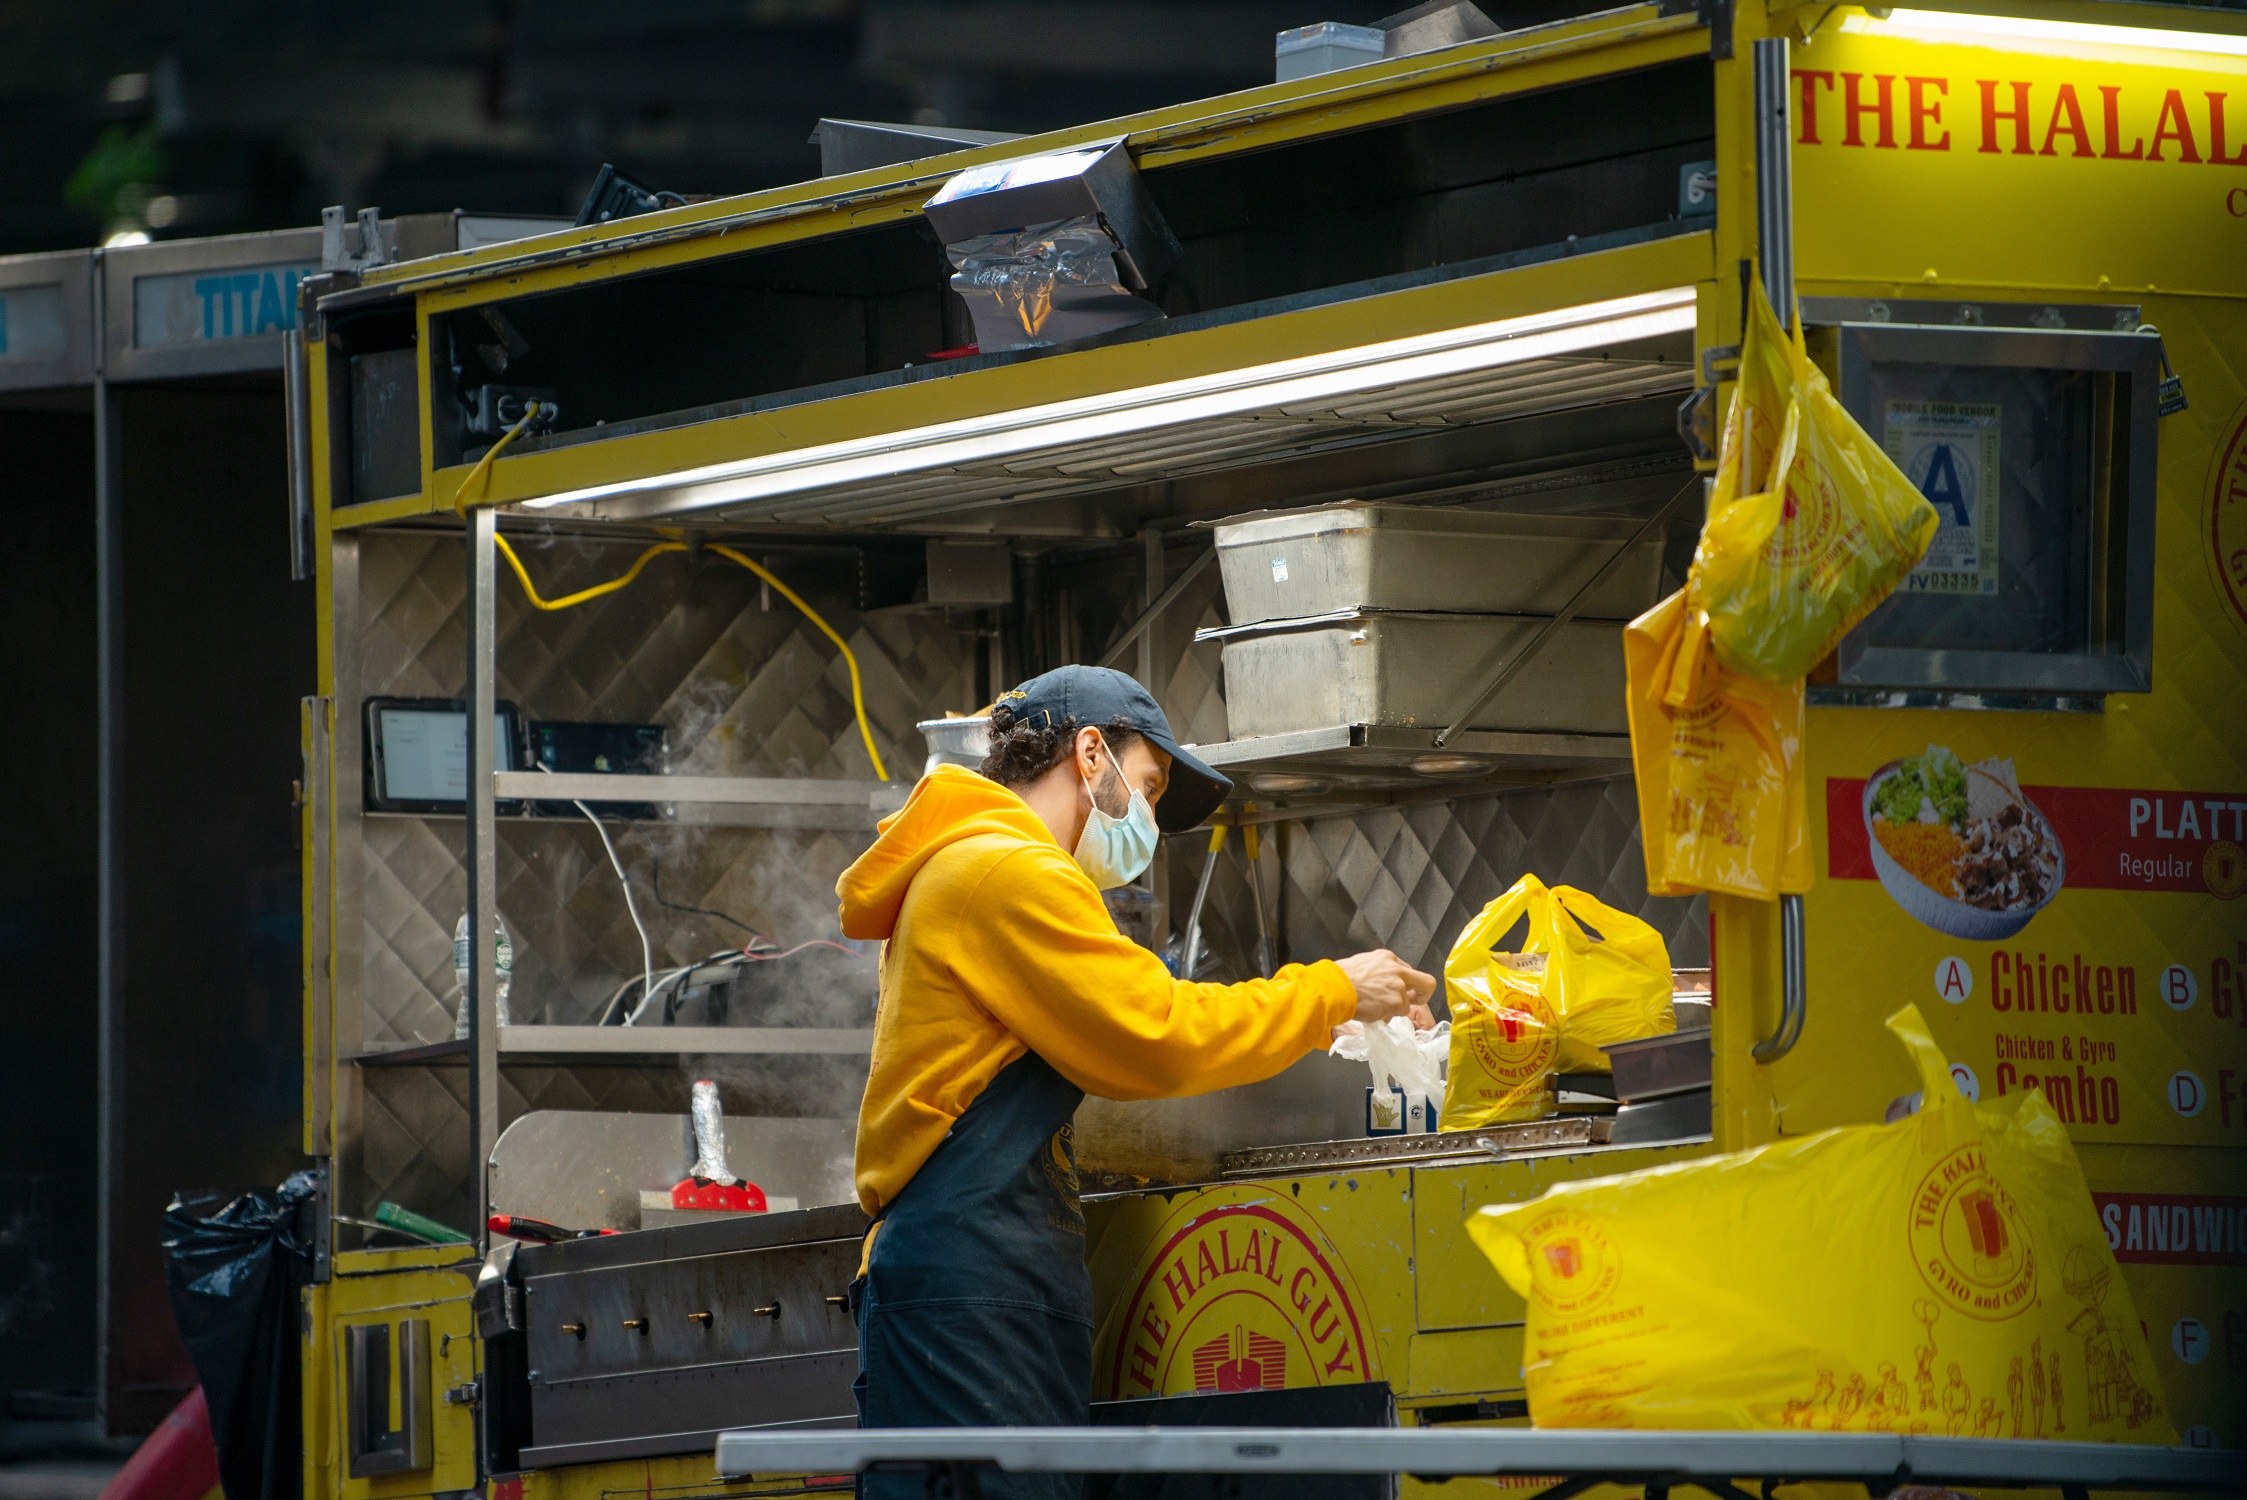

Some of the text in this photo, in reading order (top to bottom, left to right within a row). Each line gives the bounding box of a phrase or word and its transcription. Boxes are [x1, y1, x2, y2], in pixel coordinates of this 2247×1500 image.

[1790, 69, 2247, 167] THE HALAL
[1932, 403, 1955, 414] FOOD
[1959, 405, 1996, 416] VENDOR
[1922, 444, 1970, 527] A
[2130, 797, 2247, 842] PLATT
[2120, 852, 2193, 883] Regular
[1943, 960, 1965, 998] A
[1991, 950, 2137, 1015] Chicken
[2169, 968, 2190, 1004] B
[1475, 1037, 1553, 1078] GYRO and CHICKEN
[1996, 1033, 2116, 1065] Chicken & Gyro
[1478, 1089, 1493, 1098] WE
[2176, 1074, 2197, 1112] D
[1915, 1179, 1948, 1231] THE
[1928, 1258, 1971, 1303] GYRO
[1974, 1294, 2001, 1310] and
[1127, 1301, 1172, 1399] HE
[1162, 1228, 1287, 1315] HALAL
[2181, 1321, 2198, 1358] F
